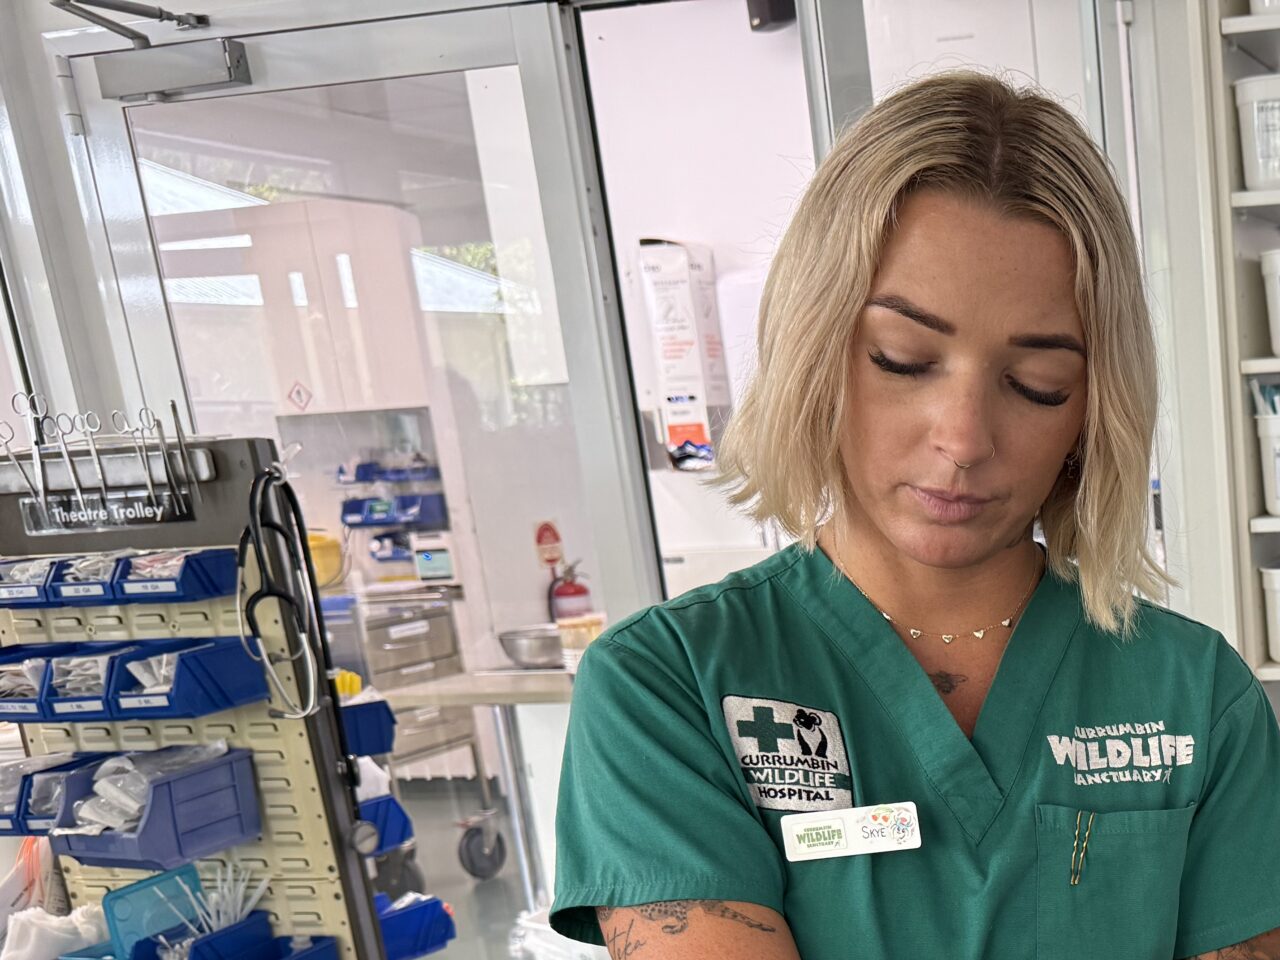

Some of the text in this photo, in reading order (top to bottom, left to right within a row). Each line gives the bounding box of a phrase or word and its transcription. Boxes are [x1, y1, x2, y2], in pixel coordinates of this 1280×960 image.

[52, 502, 163, 523] Theatre Trolley
[1046, 734, 1195, 771] WILDLIFE
[741, 754, 839, 771] CURRUMBIN
[750, 768, 837, 788] WILDLIFE
[758, 786, 835, 801] HOSPITAL
[796, 829, 843, 845] WILDLIFE
